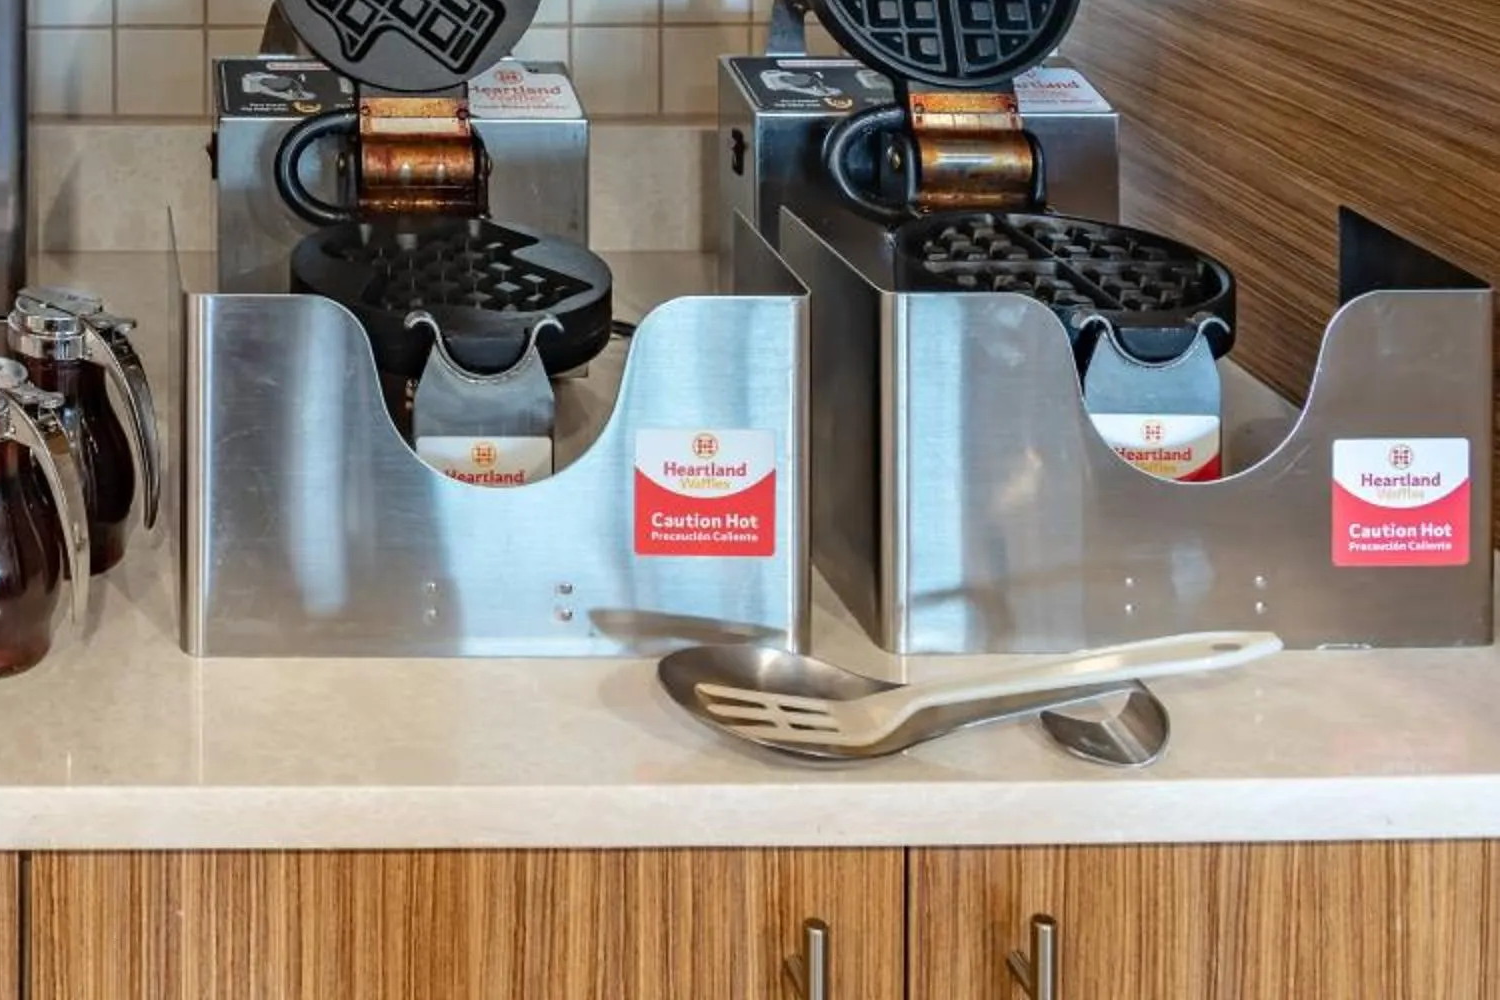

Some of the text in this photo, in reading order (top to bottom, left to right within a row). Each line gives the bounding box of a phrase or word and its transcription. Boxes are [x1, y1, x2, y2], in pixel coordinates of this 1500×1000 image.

[663, 461, 747, 477] Heartland
[681, 478, 730, 490] Waffles
[1361, 472, 1441, 487] Heartland
[651, 512, 760, 529] Caution Hot
[713, 531, 759, 543] Caliente
[1348, 522, 1453, 538] Caution Hot
[1408, 540, 1453, 552] Caliente
